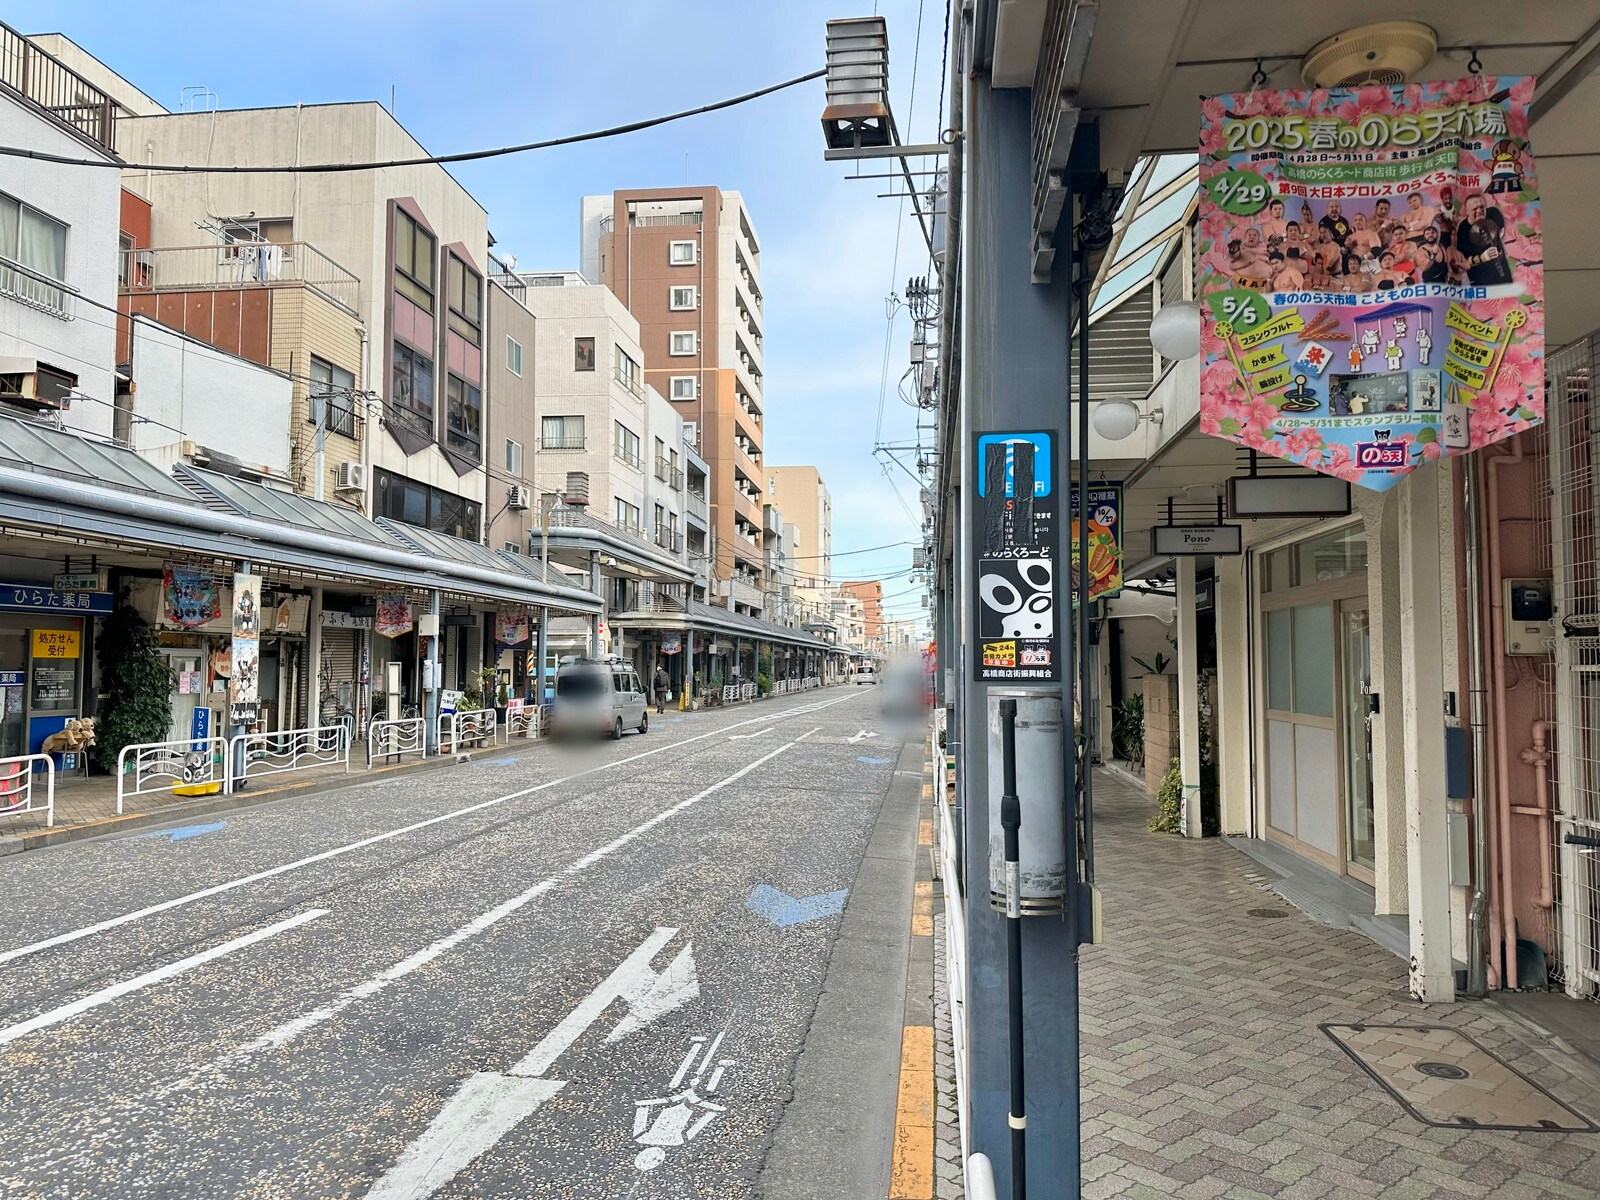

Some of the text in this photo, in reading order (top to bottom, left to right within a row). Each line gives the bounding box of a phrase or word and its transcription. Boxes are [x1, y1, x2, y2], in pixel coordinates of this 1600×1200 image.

[1227, 119, 1304, 152] 2025
[1214, 176, 1266, 206] 4/29
[1279, 182, 1308, 199] 第9回
[1310, 185, 1393, 199] 大日本プロレス
[1274, 294, 1357, 306] 春ののら天市場
[1361, 285, 1427, 305] こどもの日
[1223, 296, 1256, 324] 5/5
[1449, 311, 1493, 335] テントイベント
[1241, 322, 1294, 345] フランクフルト
[1252, 353, 1276, 367] かき氷
[1361, 447, 1404, 464] のら天
[1097, 507, 1114, 524] 10/27
[1183, 534, 1213, 543] Pono
[56, 580, 98, 589] ひらた薬局
[14, 589, 92, 609] ひらた薬局
[38, 633, 75, 645] 処方せん
[47, 645, 67, 657] 受付
[0, 673, 17, 683] 薬局
[982, 669, 1052, 678] 高橋商店街振興組合
